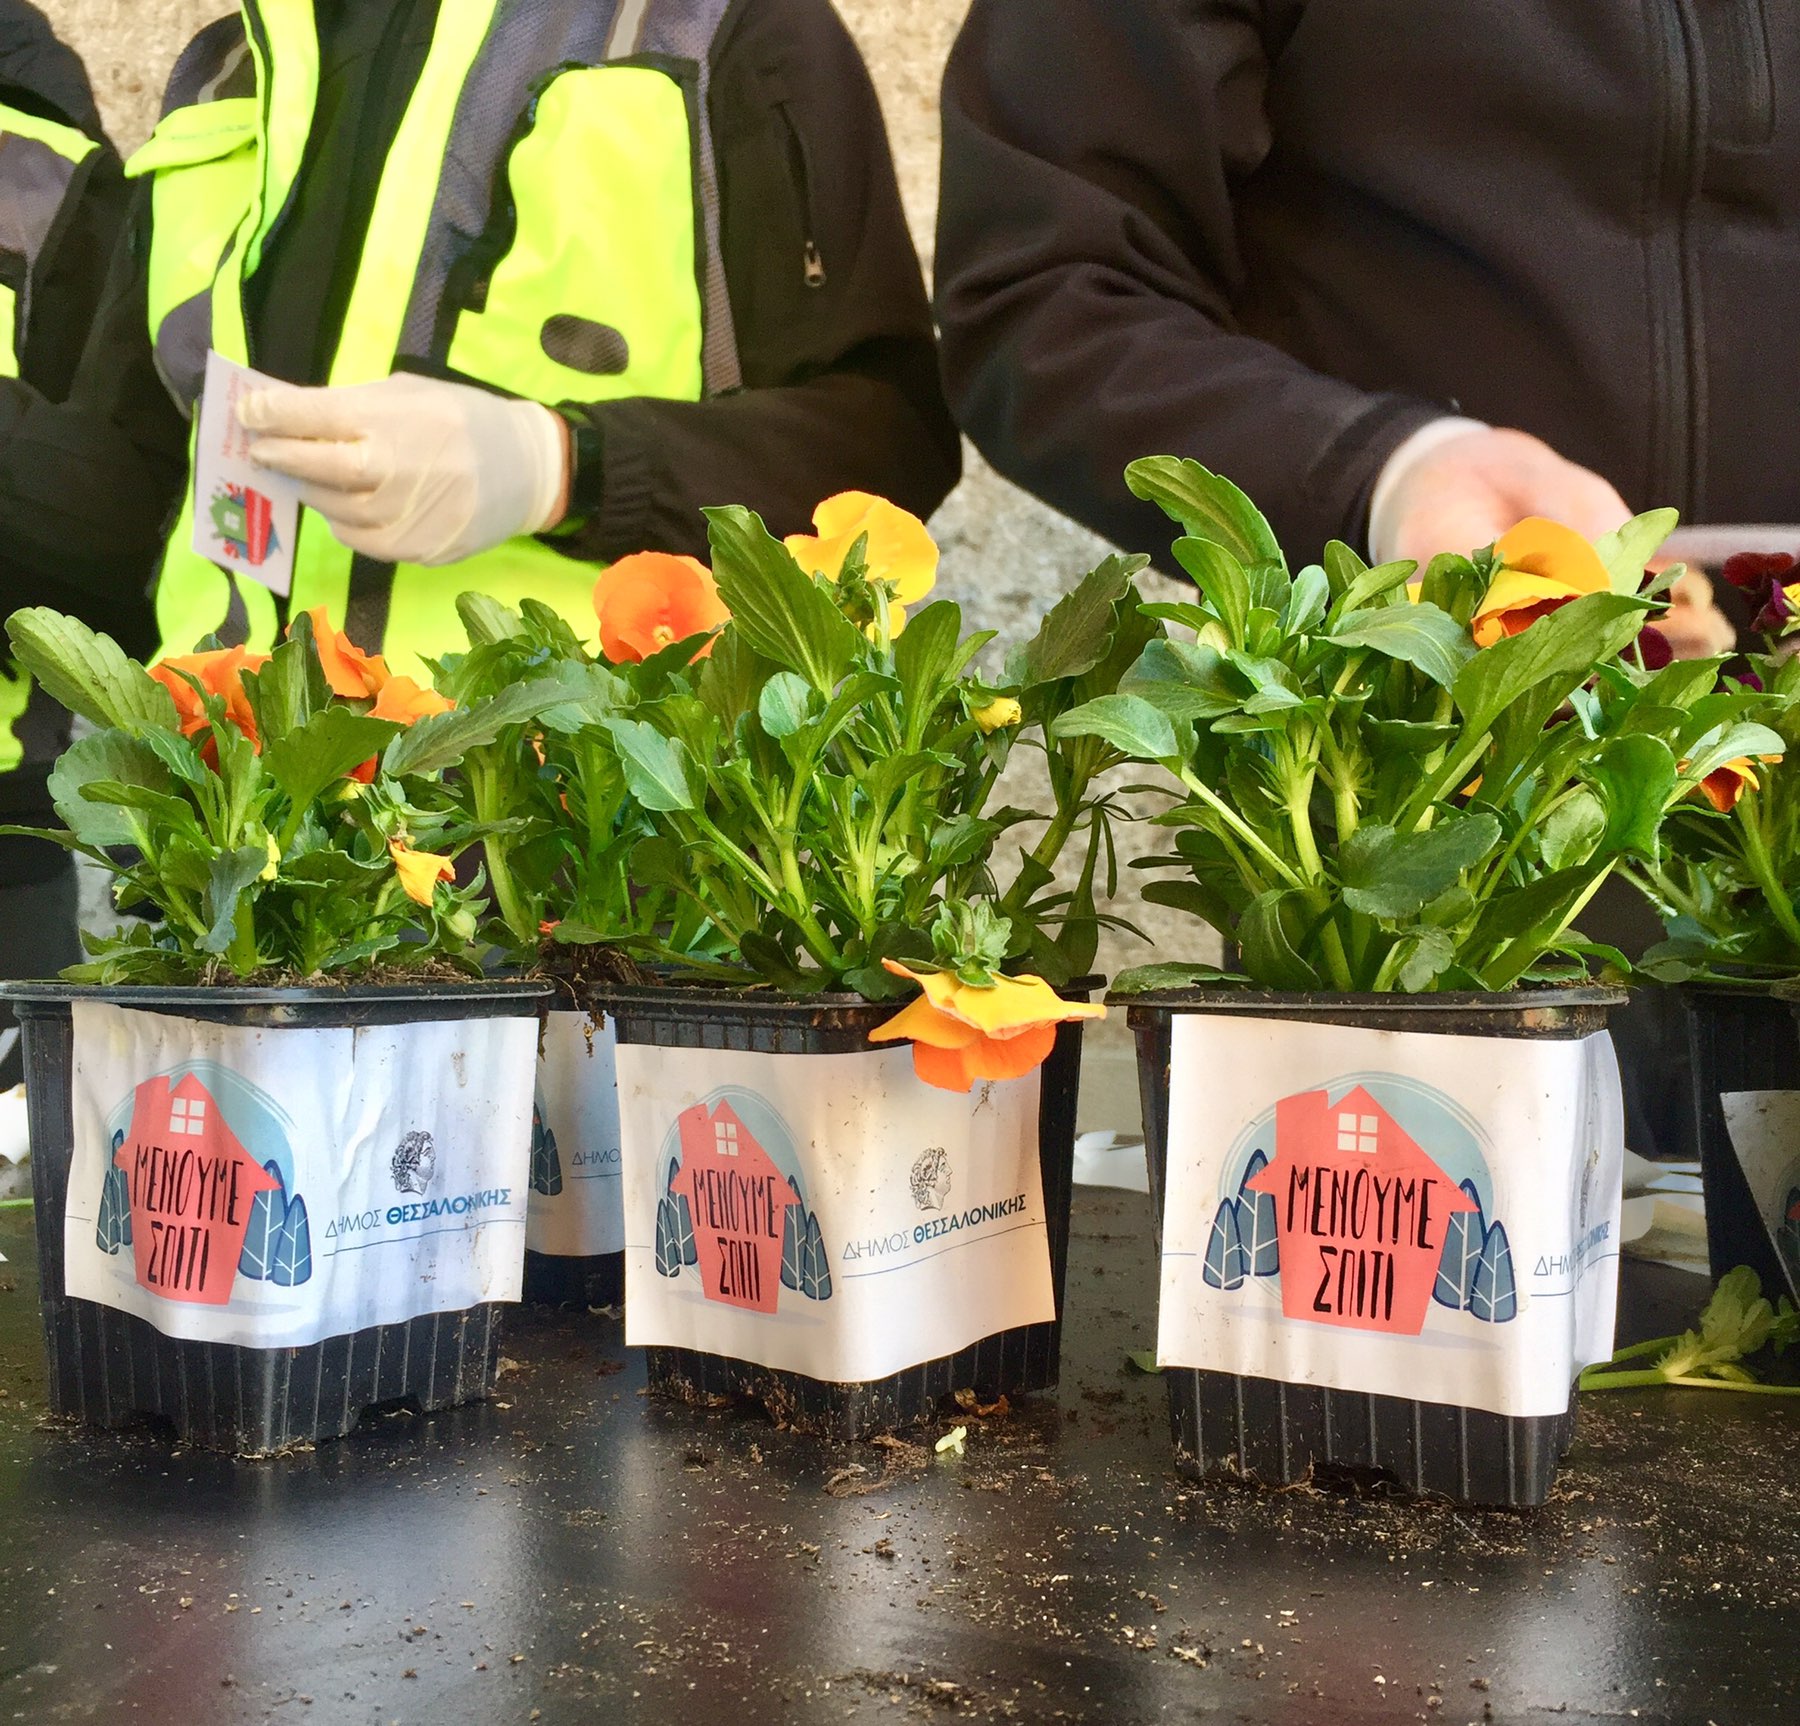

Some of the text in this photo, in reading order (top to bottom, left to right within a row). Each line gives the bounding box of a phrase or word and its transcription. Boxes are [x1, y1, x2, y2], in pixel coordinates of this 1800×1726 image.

[133, 1143, 244, 1226] ΜΕΝΟΥΜΕ
[572, 1147, 621, 1165] ΔΗΜΟ
[325, 1209, 382, 1238] ΔΗΜΟΣ
[693, 1168, 780, 1240] ΜΕΝΟΥΜΕ
[842, 1193, 1027, 1260] ΔΗΜΟΣ ΘΕΣΣΑΛΟΝΙΚΗΣ
[1286, 1164, 1439, 1250] ΜΕΝΟΥΜΕ
[146, 1219, 211, 1292] ΣΠΙΤΙ
[717, 1235, 762, 1302] ΣΠΙΤΙ
[1312, 1244, 1395, 1321] ΣΠΙΤΙ
